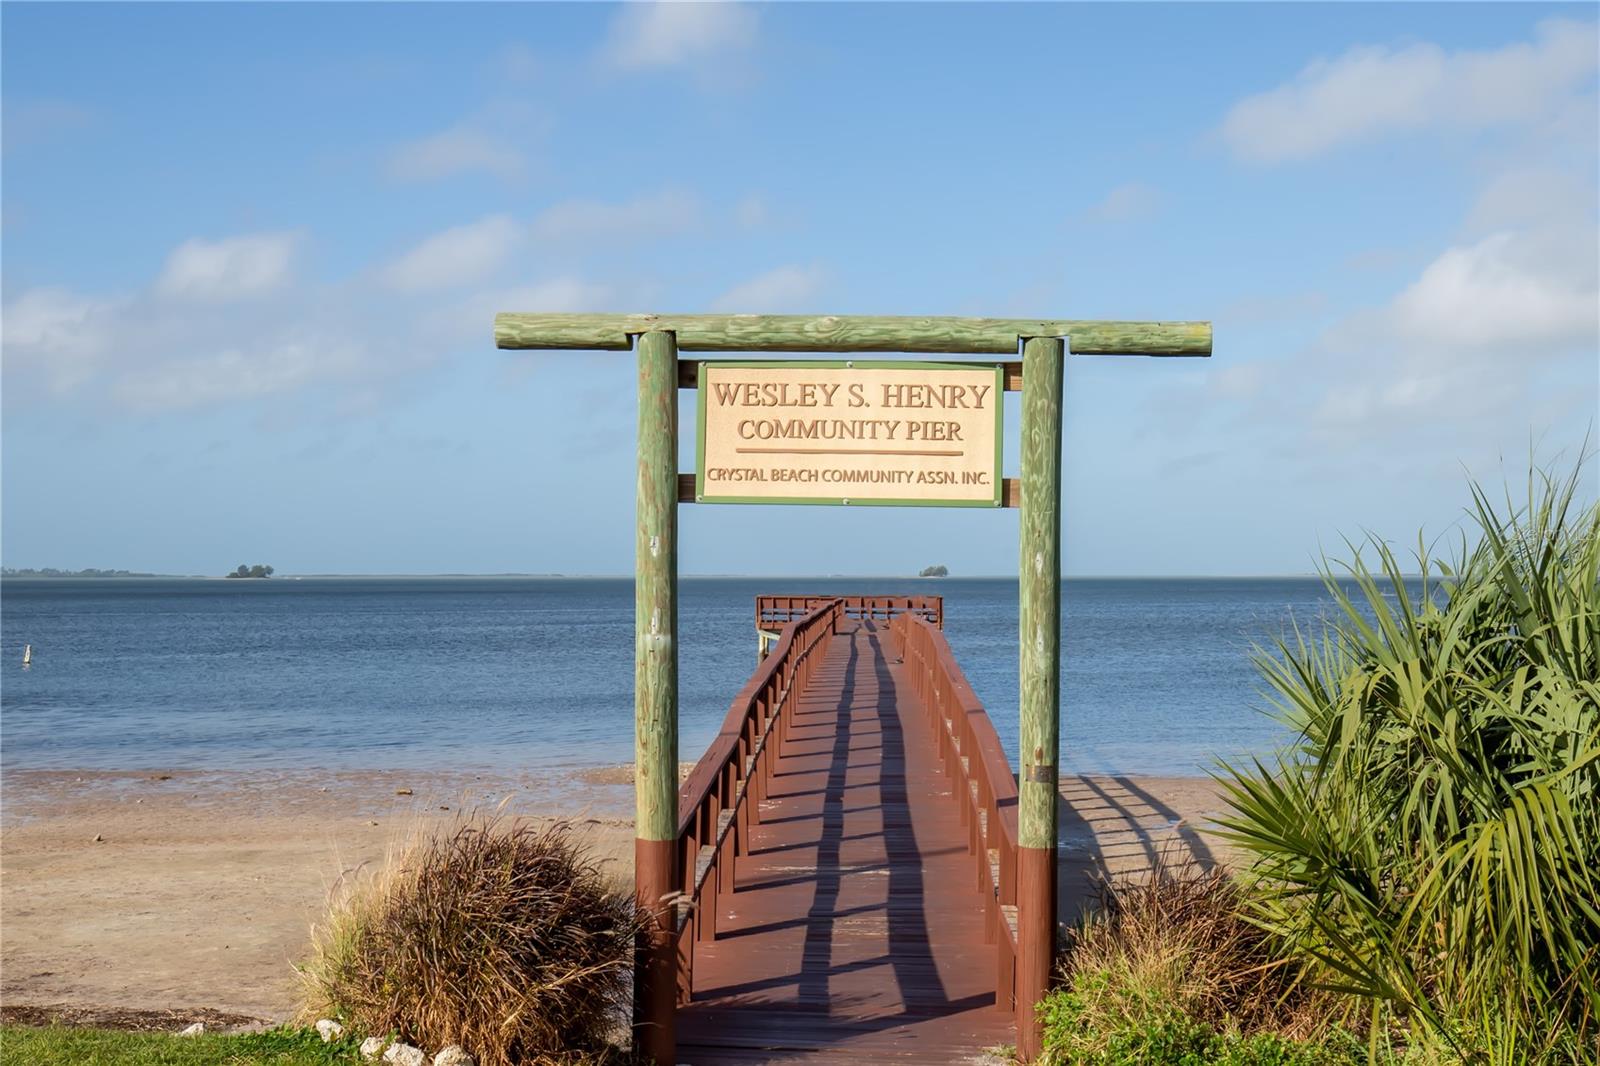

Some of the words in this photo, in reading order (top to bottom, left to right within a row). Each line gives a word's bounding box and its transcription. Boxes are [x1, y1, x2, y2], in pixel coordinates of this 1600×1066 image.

[712, 383, 840, 407] WESLEY
[848, 383, 870, 408] S.
[881, 384, 990, 409] HENRY
[737, 419, 901, 440] COMMUNITY
[905, 421, 964, 441] PIER
[707, 468, 768, 482] CRYSTAL
[771, 469, 819, 483] BEACH
[822, 469, 914, 484] COMMUNITY
[916, 471, 958, 485] ASSN.
[962, 472, 990, 485] INC.
